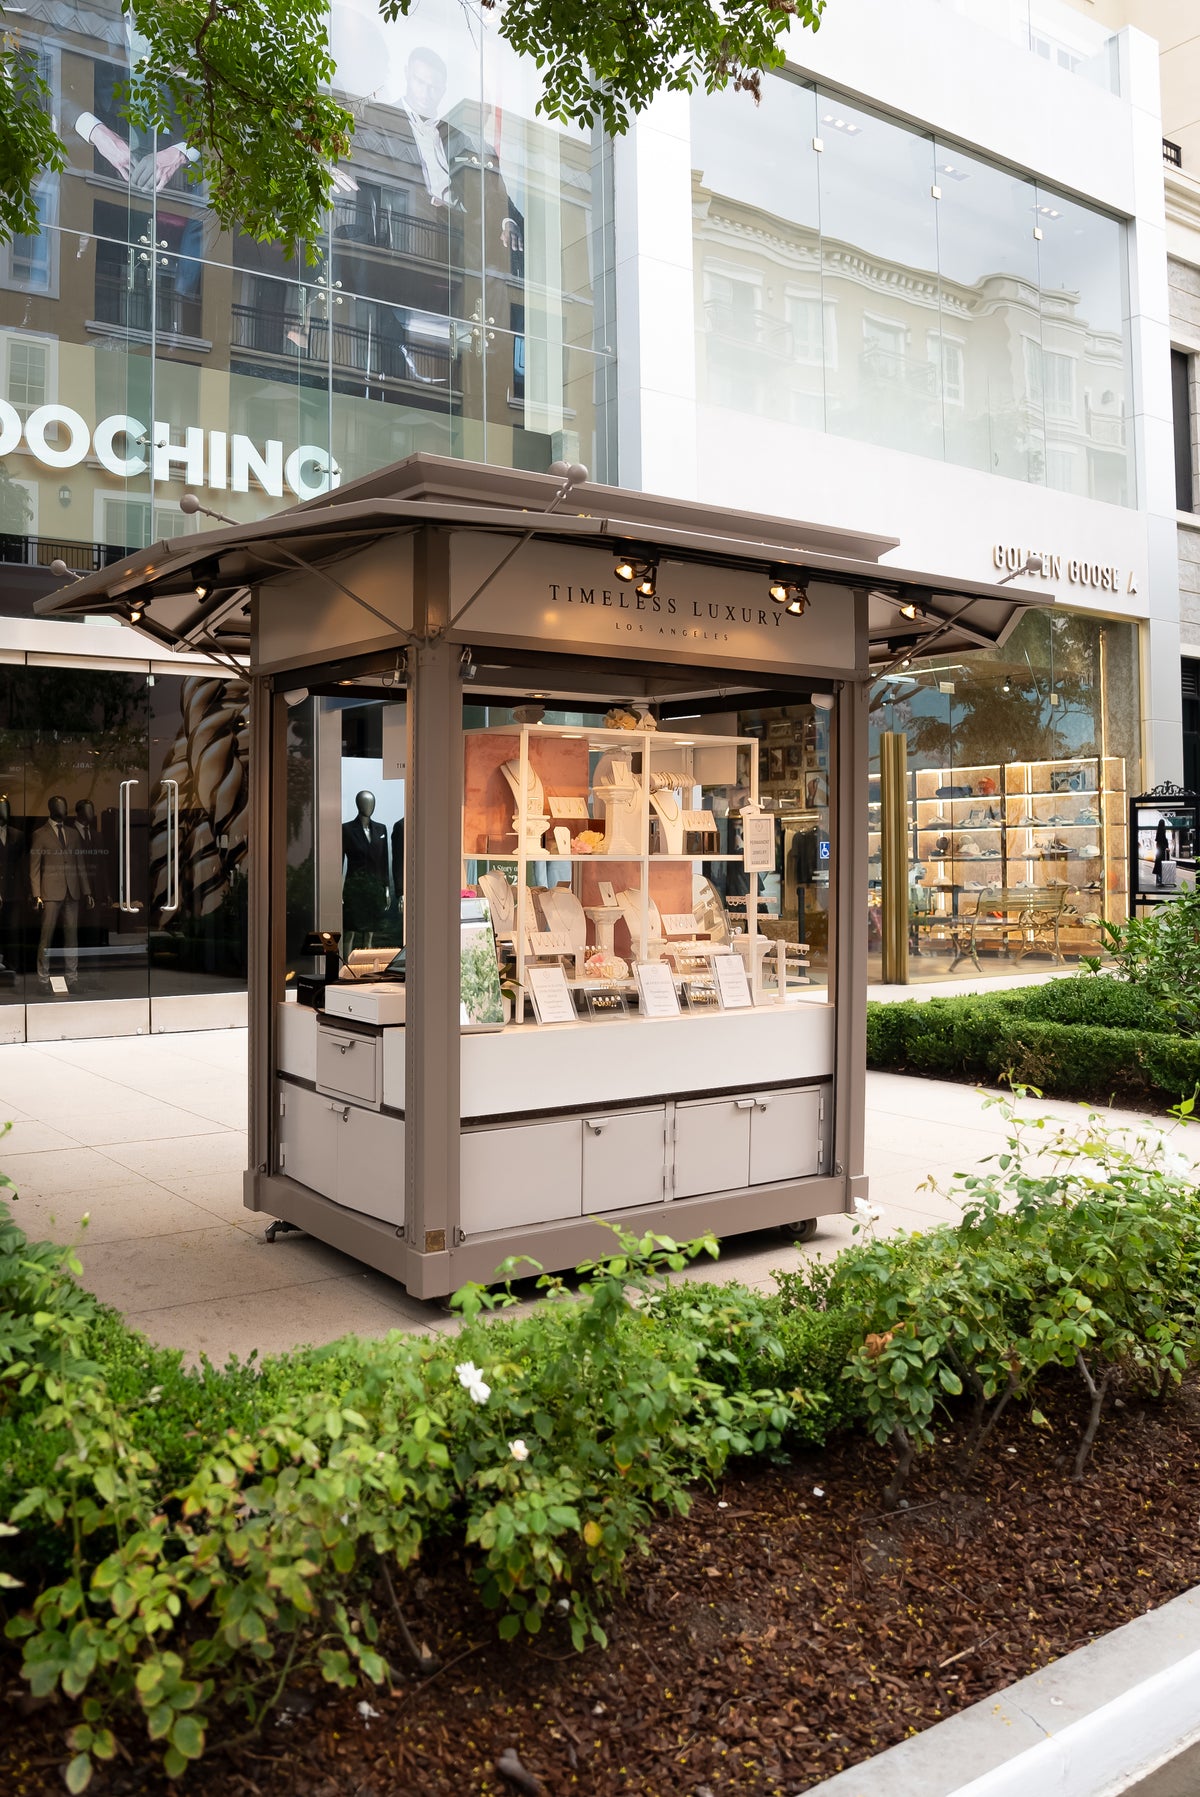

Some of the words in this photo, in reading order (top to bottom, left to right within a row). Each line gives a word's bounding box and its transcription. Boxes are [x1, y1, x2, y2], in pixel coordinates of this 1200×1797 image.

[1068, 560, 1120, 592] GOOSE
[549, 584, 677, 614] TIMELESS
[693, 601, 783, 627] LUXURY
[615, 622, 644, 632] LOS
[658, 627, 729, 641] ANGELES
[497, 865, 512, 873] Story
